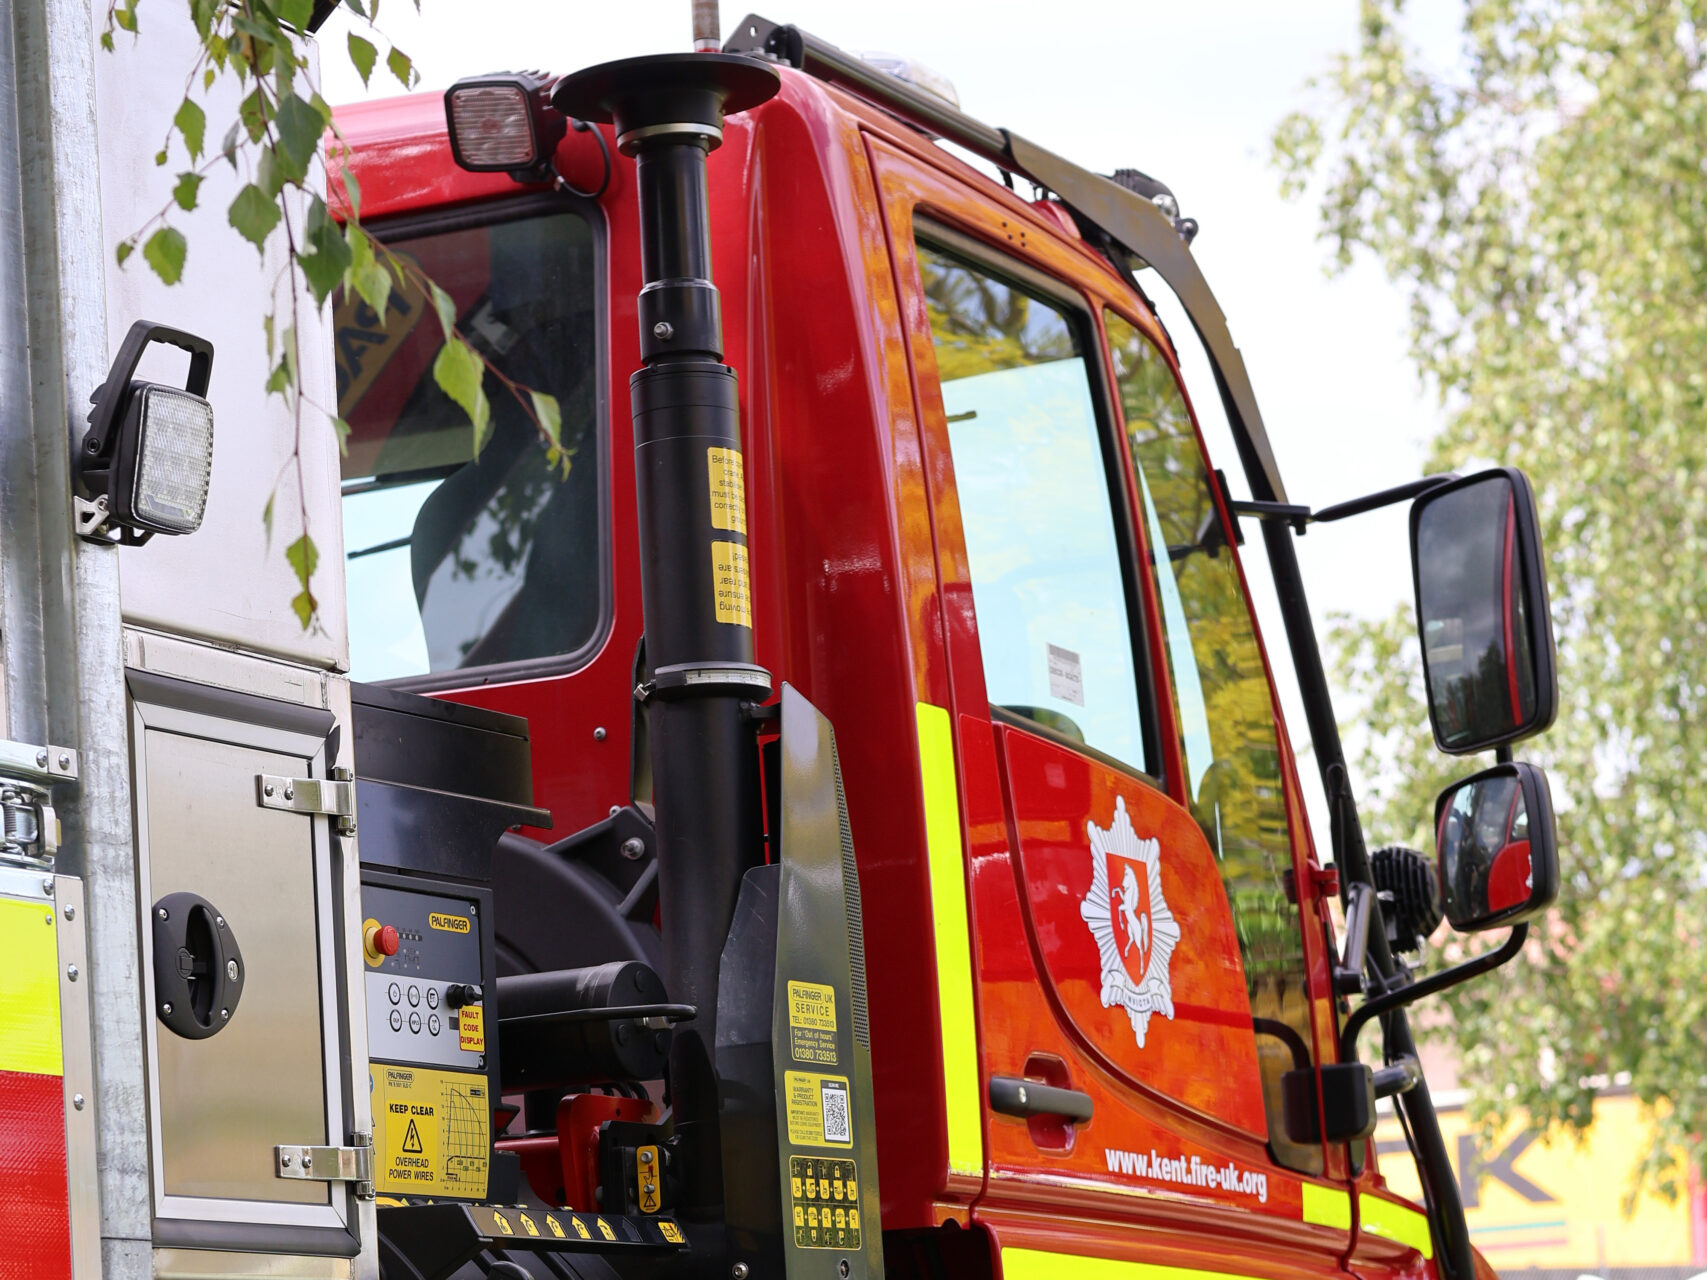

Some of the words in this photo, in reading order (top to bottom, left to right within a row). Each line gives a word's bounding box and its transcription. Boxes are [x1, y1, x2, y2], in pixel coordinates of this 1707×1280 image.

[431, 915, 468, 931] PALFINGER
[792, 988, 822, 1001] PALFINGER
[824, 993, 833, 1004] UK
[1125, 994, 1150, 1007] INVICTA
[461, 1009, 479, 1020] FAULT
[795, 1002, 830, 1017] SERVICE
[792, 1015, 802, 1024] TEL:
[463, 1023, 479, 1032] CODE
[460, 1035, 484, 1046] DISPLAY
[794, 1038, 818, 1049] Emergency
[819, 1040, 835, 1049] Service
[794, 1047, 814, 1059] 01380
[815, 1050, 837, 1062] 733513
[388, 1071, 413, 1081] PALFINGER
[389, 1103, 409, 1114] KEEP
[410, 1105, 434, 1117] CLEAR
[395, 1156, 429, 1168] OVERHEAD
[388, 1168, 412, 1180] POWER
[413, 1170, 434, 1182] WIRES
[1105, 1148, 1268, 1203] www.kent.fire-uk.org
